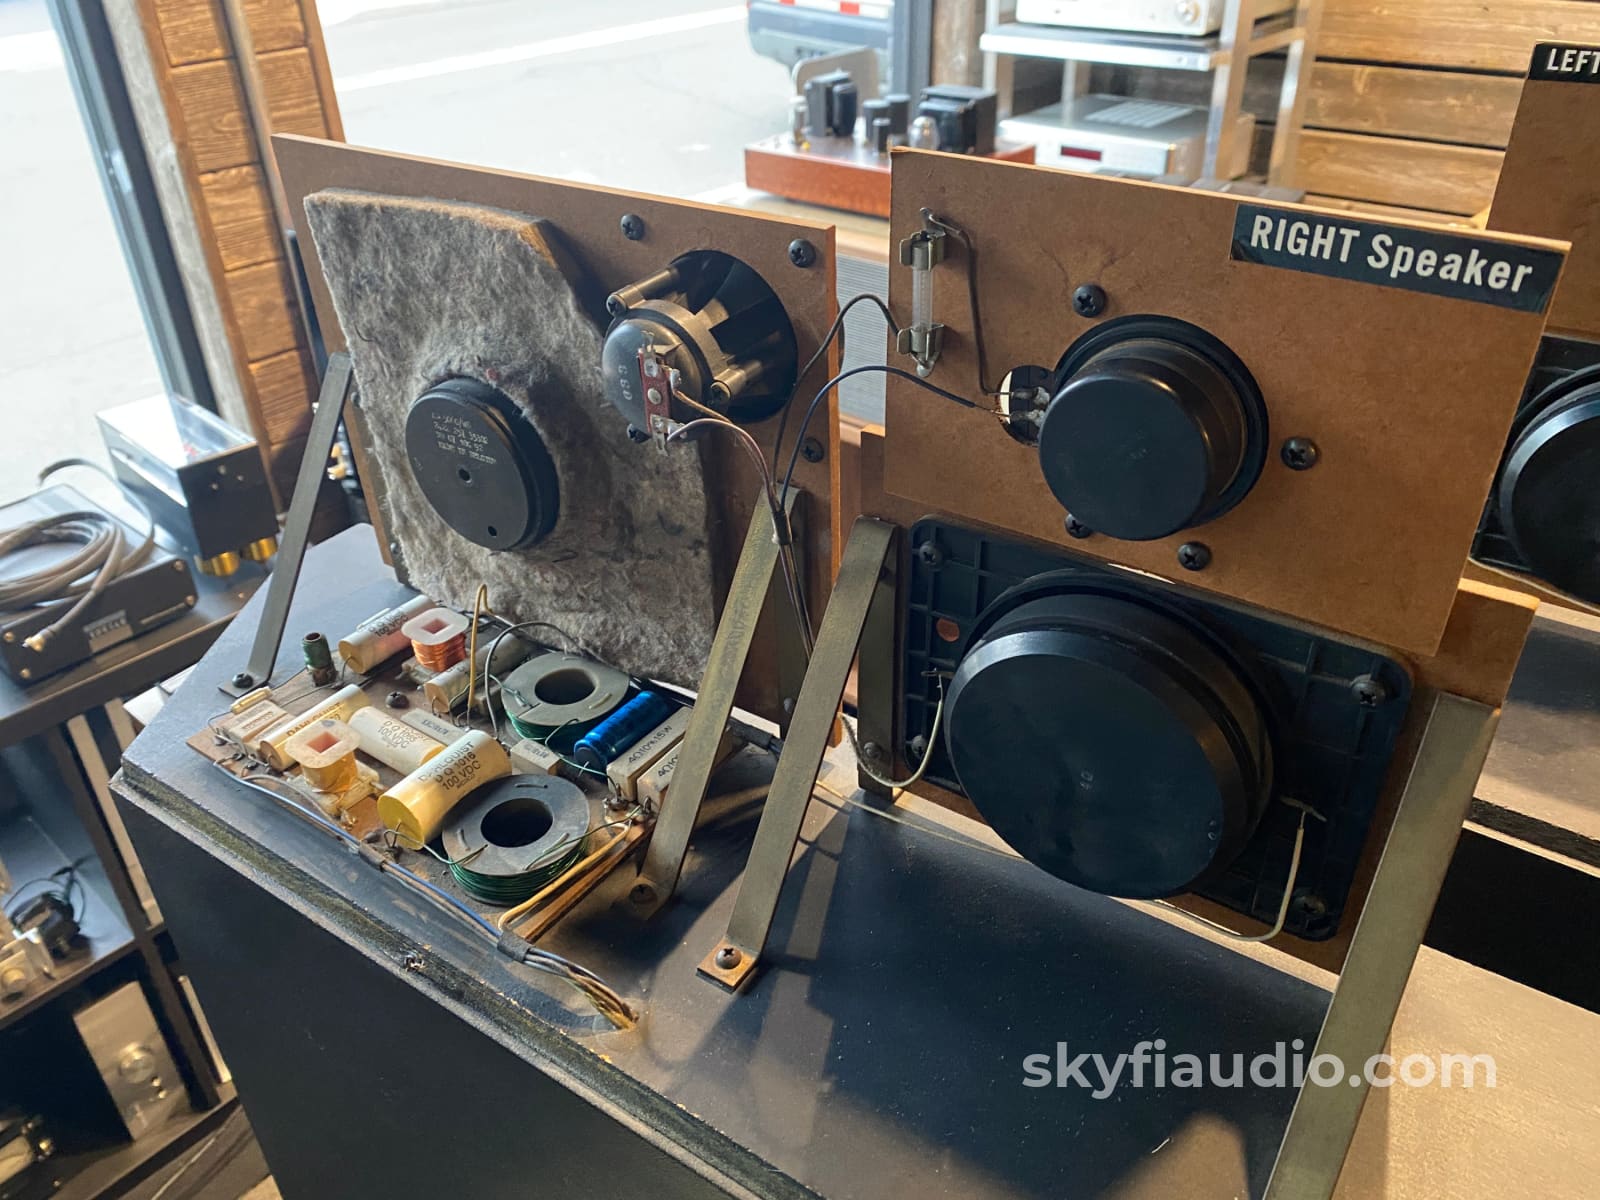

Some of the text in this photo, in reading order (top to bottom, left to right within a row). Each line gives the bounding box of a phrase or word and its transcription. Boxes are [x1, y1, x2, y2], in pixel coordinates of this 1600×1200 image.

[1546, 48, 1600, 74] LEFT
[1250, 214, 1534, 293] RIGHT Speaker
[377, 726, 393, 738] 100
[391, 732, 410, 749] VDC
[454, 751, 477, 769] 1016
[442, 760, 481, 790] 100 VDC
